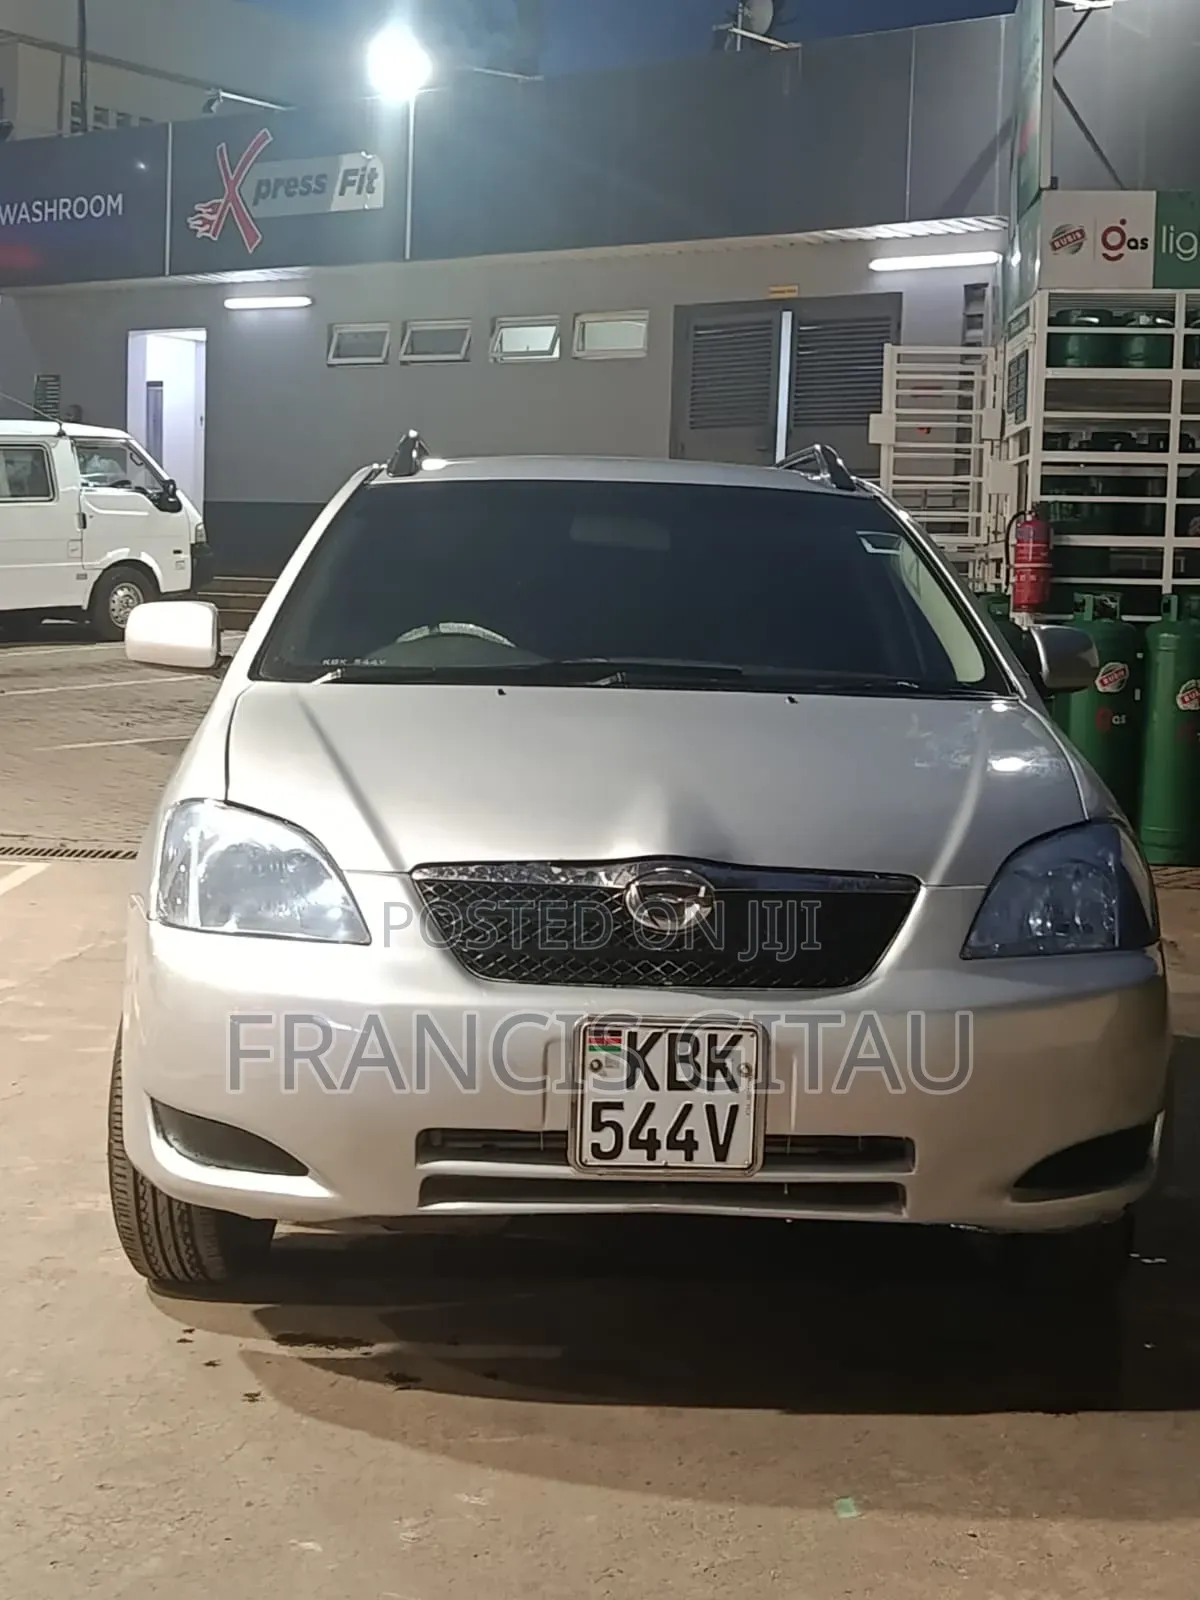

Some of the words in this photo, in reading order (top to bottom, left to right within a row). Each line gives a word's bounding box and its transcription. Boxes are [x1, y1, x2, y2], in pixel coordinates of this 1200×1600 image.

[0, 193, 123, 226] WASHROOM
[187, 127, 328, 254] Xpress
[338, 166, 380, 197] Fit
[1053, 228, 1086, 251] RUBIS
[1101, 218, 1149, 262] gas
[626, 1030, 743, 1093] KBK
[591, 1101, 739, 1162] 544V
